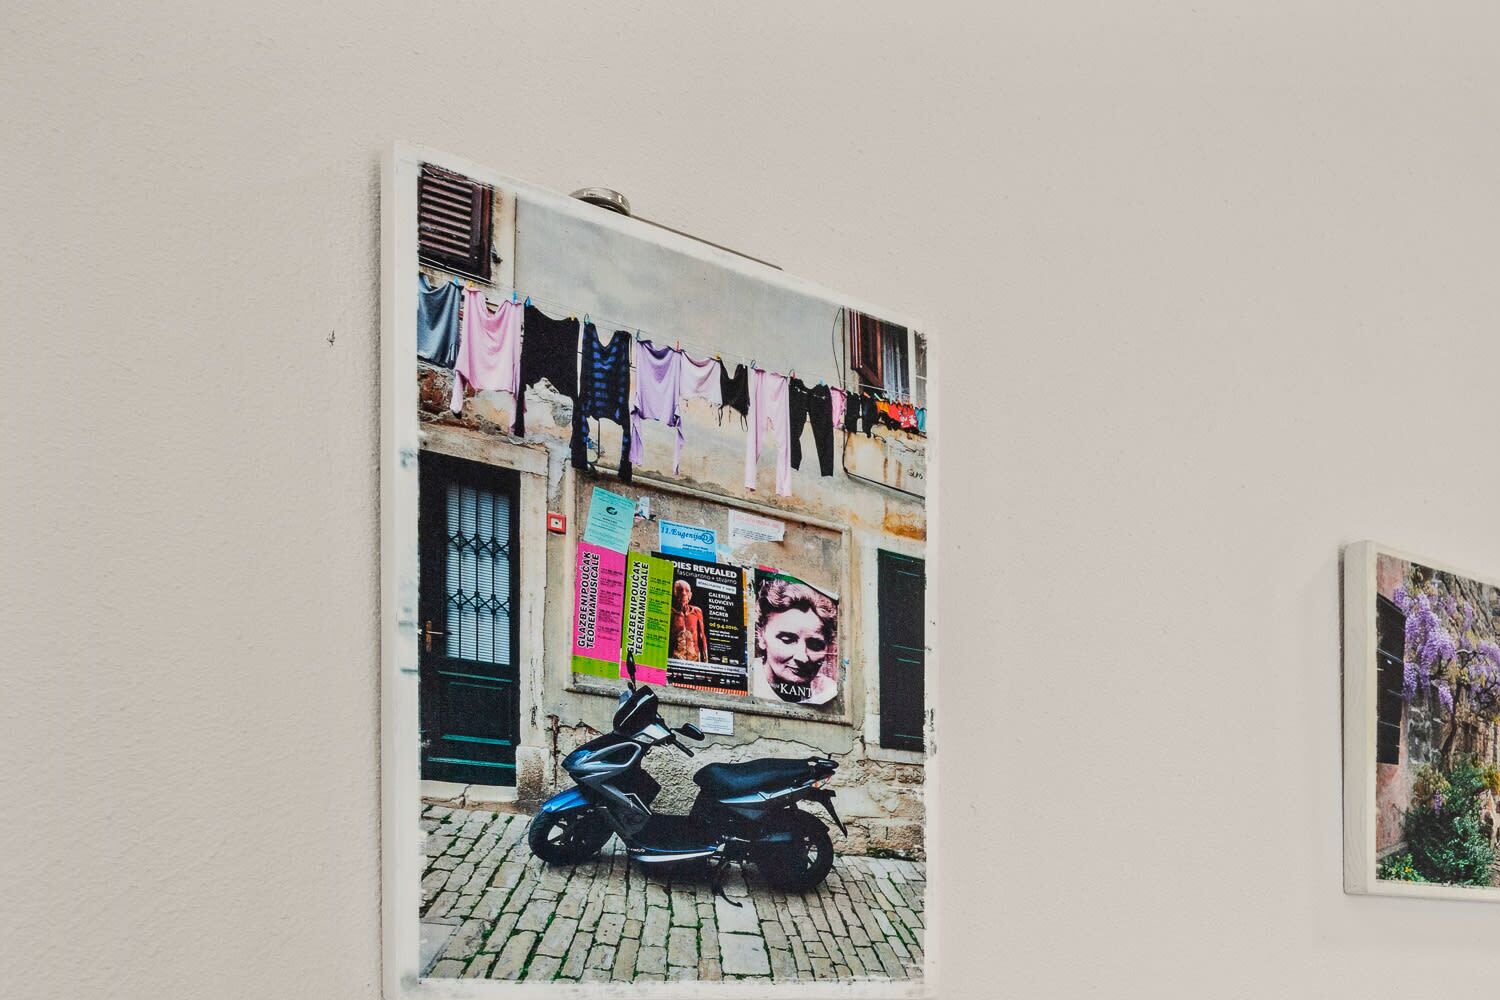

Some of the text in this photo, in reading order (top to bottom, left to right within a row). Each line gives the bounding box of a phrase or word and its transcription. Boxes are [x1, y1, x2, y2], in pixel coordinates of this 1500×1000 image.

[693, 564, 737, 578] REVEALED
[586, 554, 599, 648] TEOREMAMUSICALE
[635, 563, 649, 655] TEOREMAMUSICALE
[708, 610, 729, 618] ZAGREB
